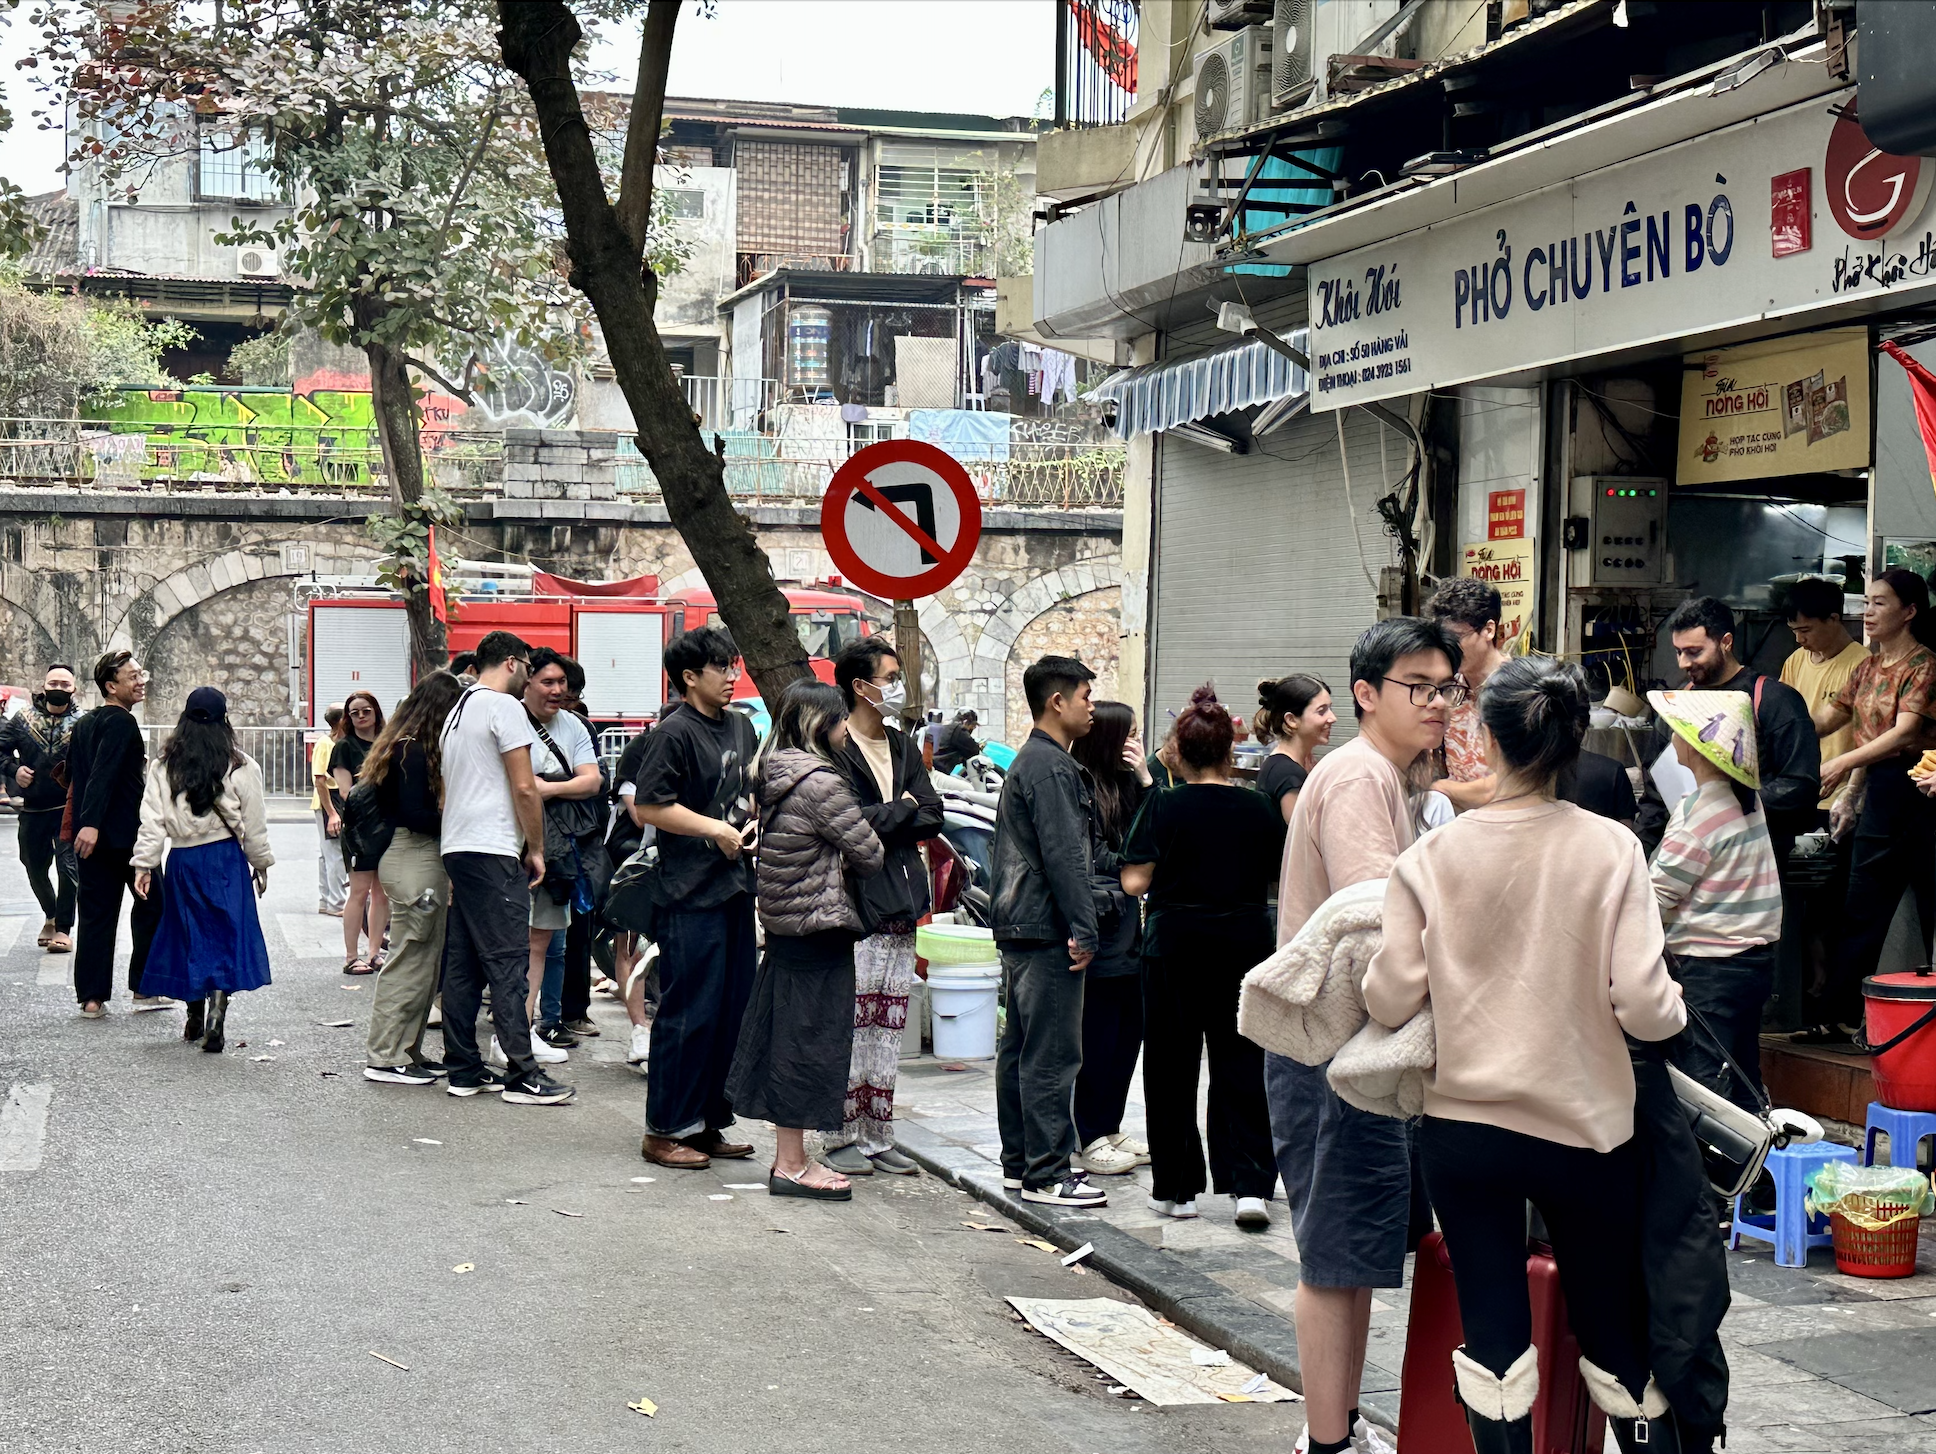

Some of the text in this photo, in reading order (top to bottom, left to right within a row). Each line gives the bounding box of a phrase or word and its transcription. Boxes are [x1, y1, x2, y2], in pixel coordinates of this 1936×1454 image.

[1454, 172, 1734, 329] PHỞ CHUYÊN BÒ
[1832, 244, 1864, 293] Phở
[1315, 263, 1402, 330] Khôi Hói
